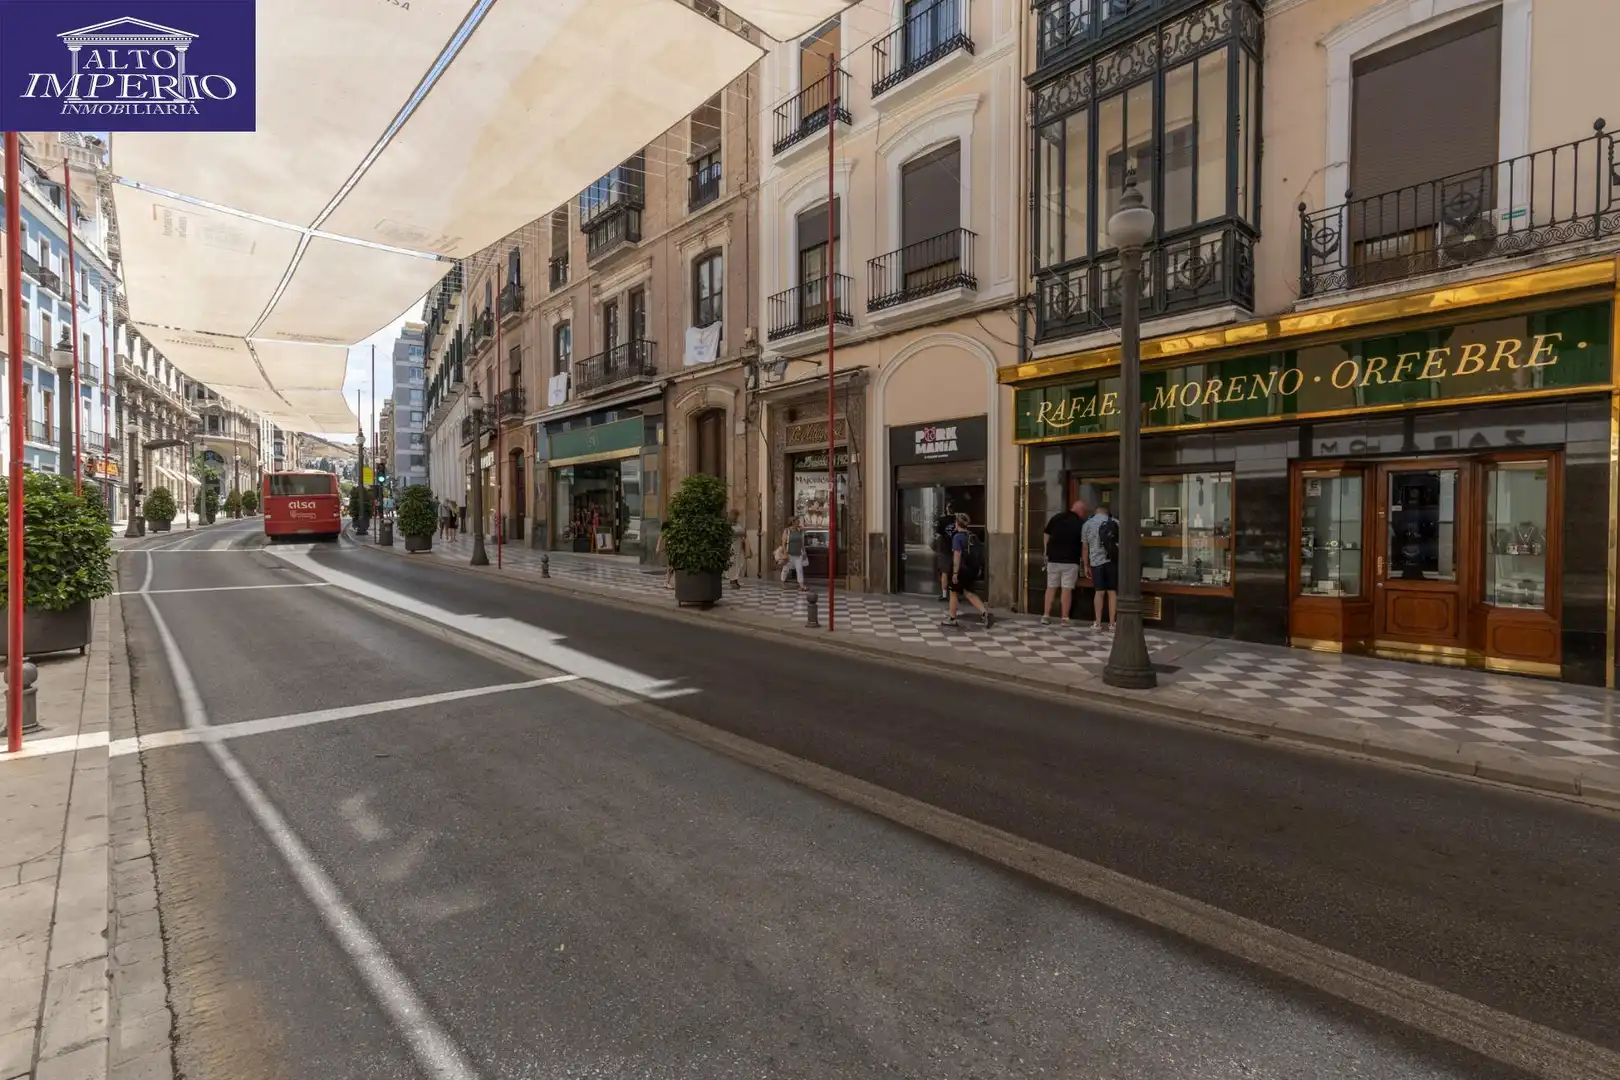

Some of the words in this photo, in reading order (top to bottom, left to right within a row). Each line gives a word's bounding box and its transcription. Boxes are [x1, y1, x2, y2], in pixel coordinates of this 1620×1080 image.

[1036, 392, 1121, 428] RAFAE
[1149, 368, 1304, 411] MORENO
[1331, 332, 1562, 389] ORFEBRE
[288, 500, 316, 509] alsa
